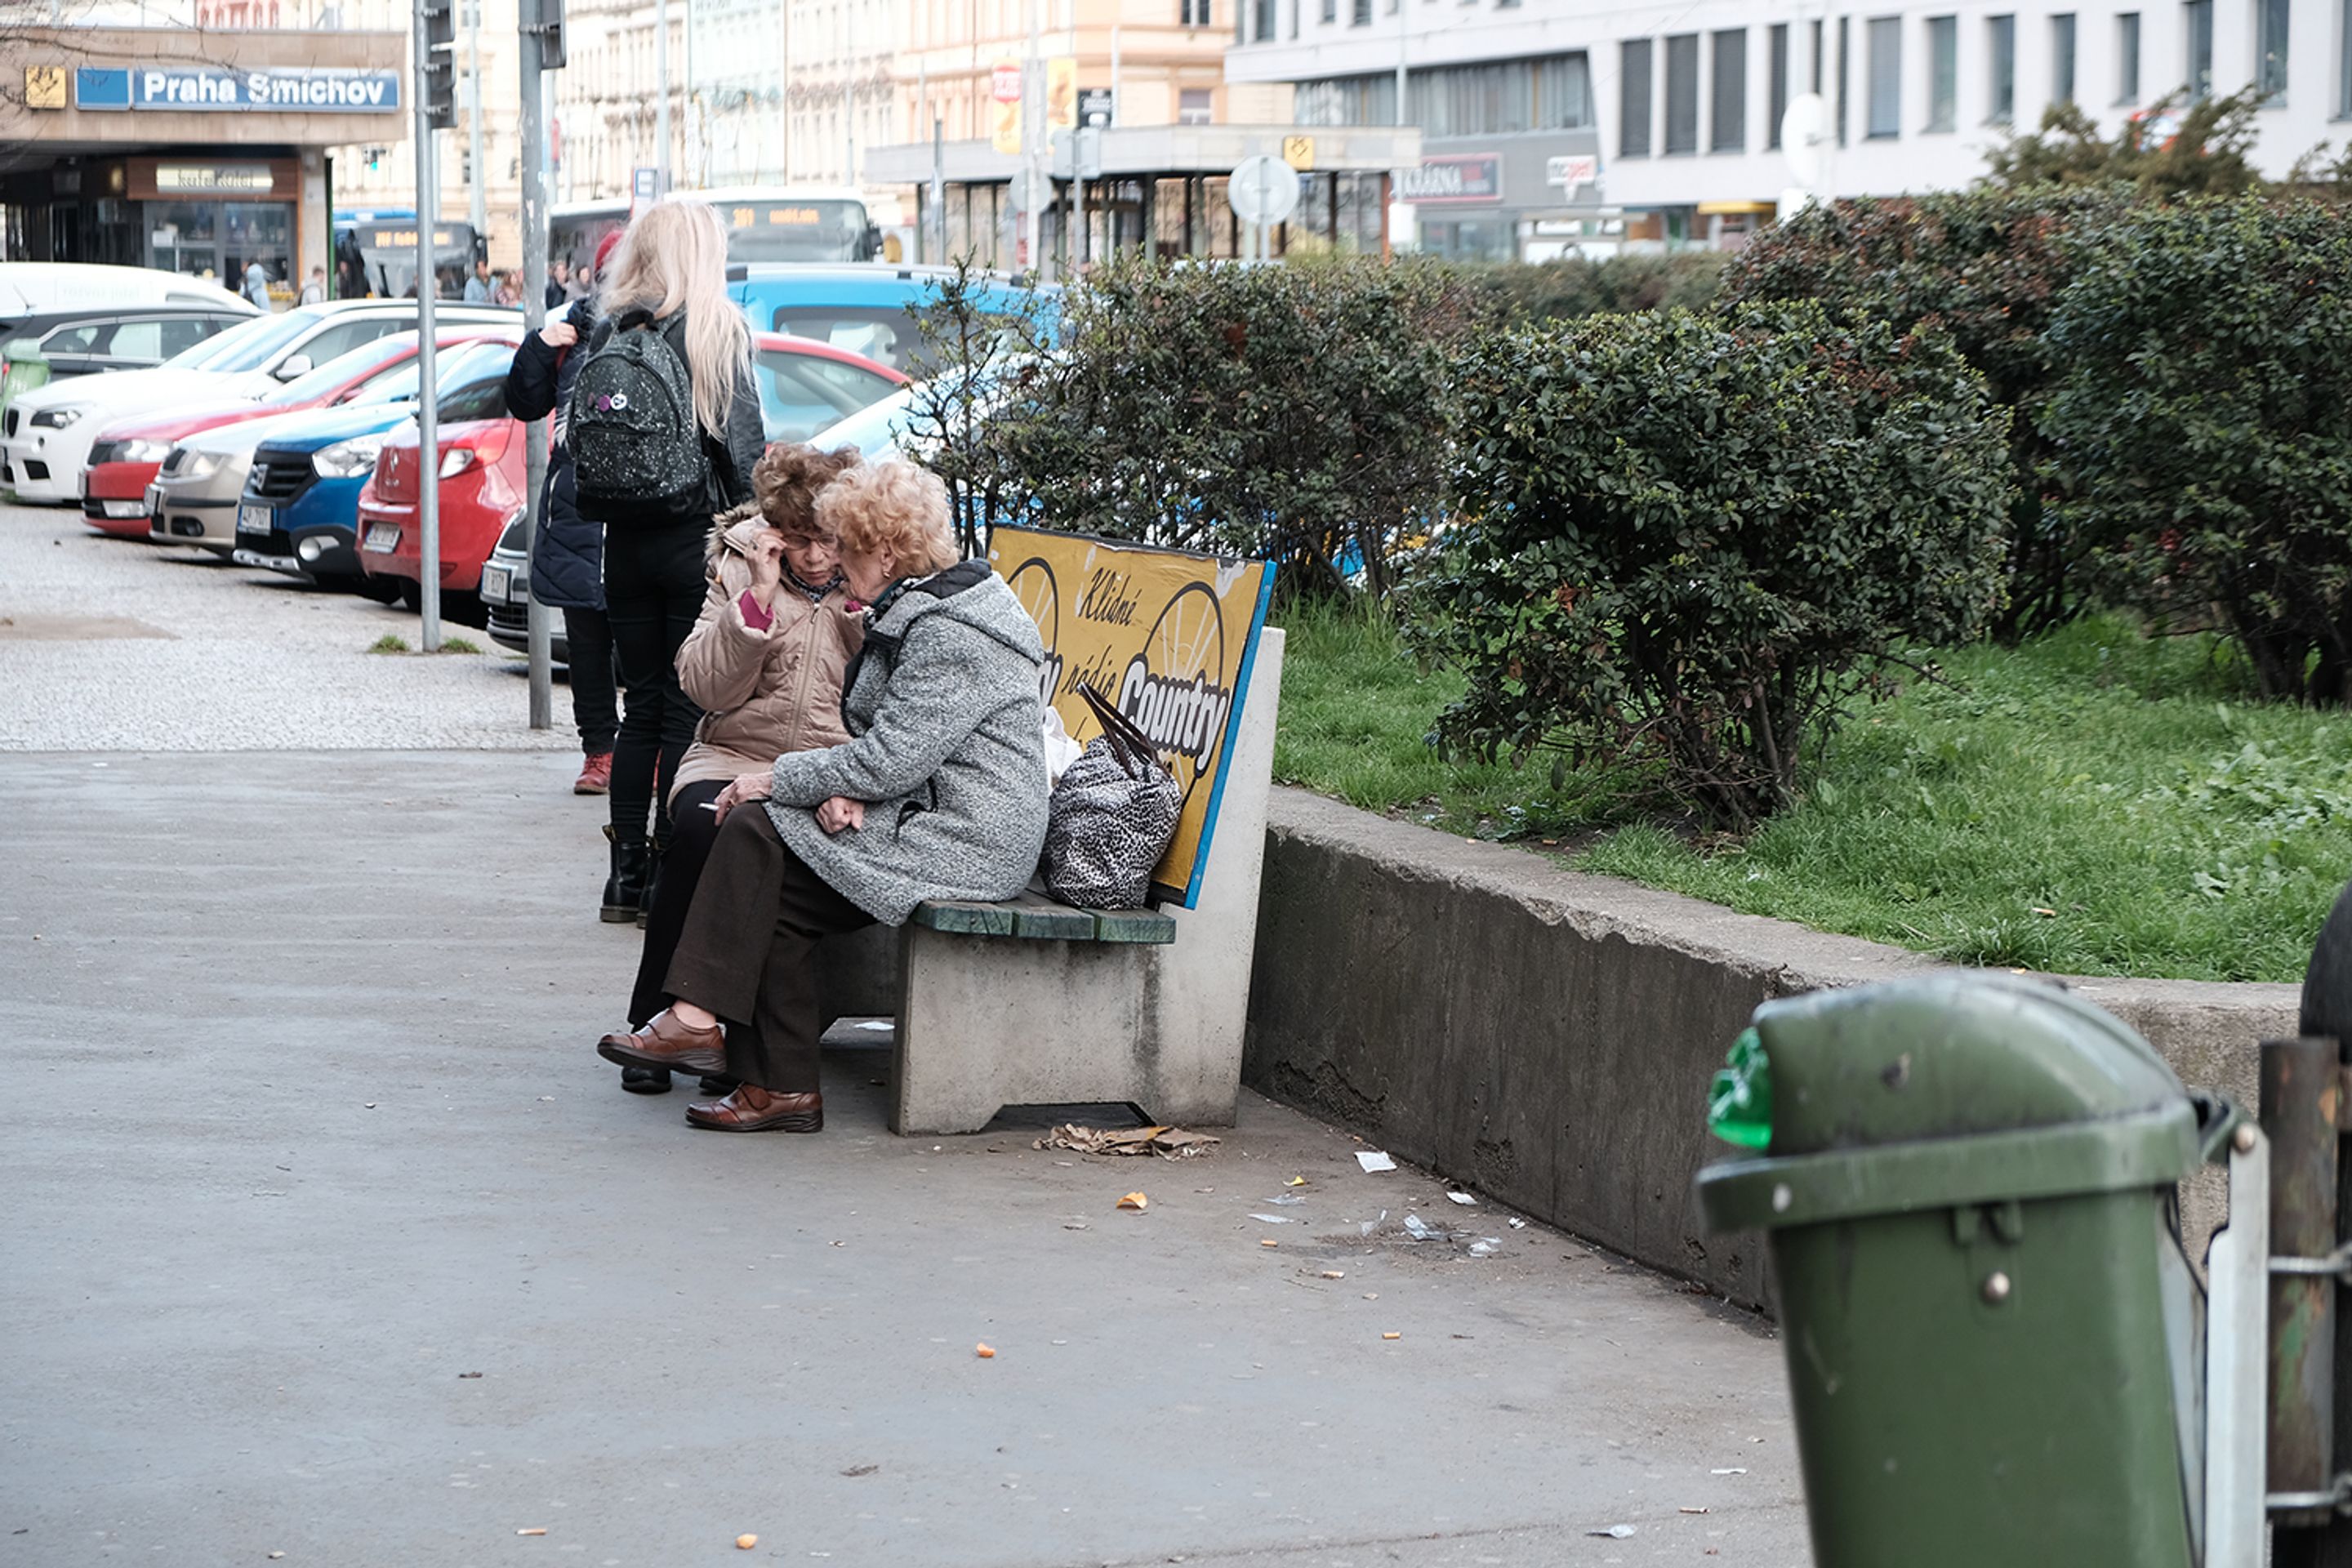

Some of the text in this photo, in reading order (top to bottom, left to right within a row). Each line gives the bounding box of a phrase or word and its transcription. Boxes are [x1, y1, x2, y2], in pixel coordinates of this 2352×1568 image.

[144, 72, 385, 105] Praha Smíchov
[1078, 567, 1143, 626] Klidné
[1062, 644, 1117, 700] rádio
[1116, 657, 1228, 773] Country
